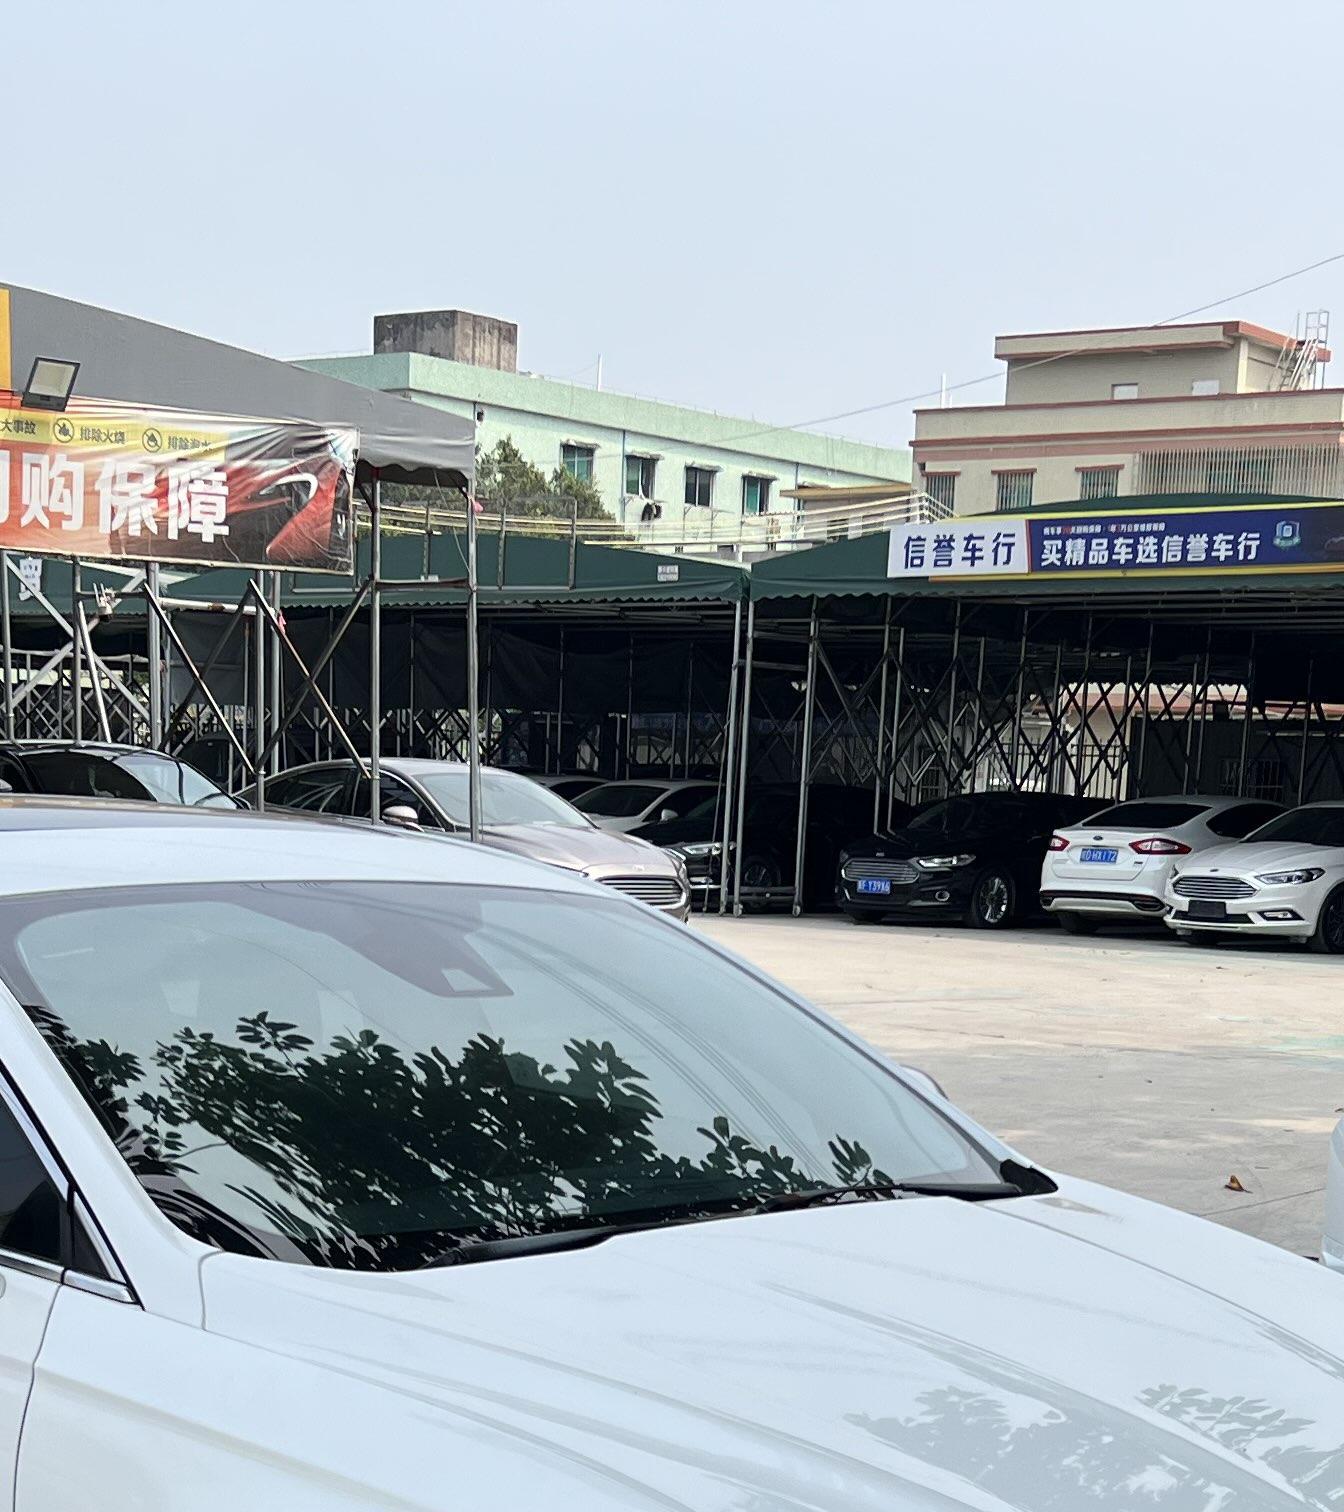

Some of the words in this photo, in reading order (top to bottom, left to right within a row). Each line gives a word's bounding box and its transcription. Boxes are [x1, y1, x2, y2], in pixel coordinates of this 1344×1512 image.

[903, 531, 1016, 569] 信誉车行
[1040, 531, 1261, 567] 买精品车选信誉车行
